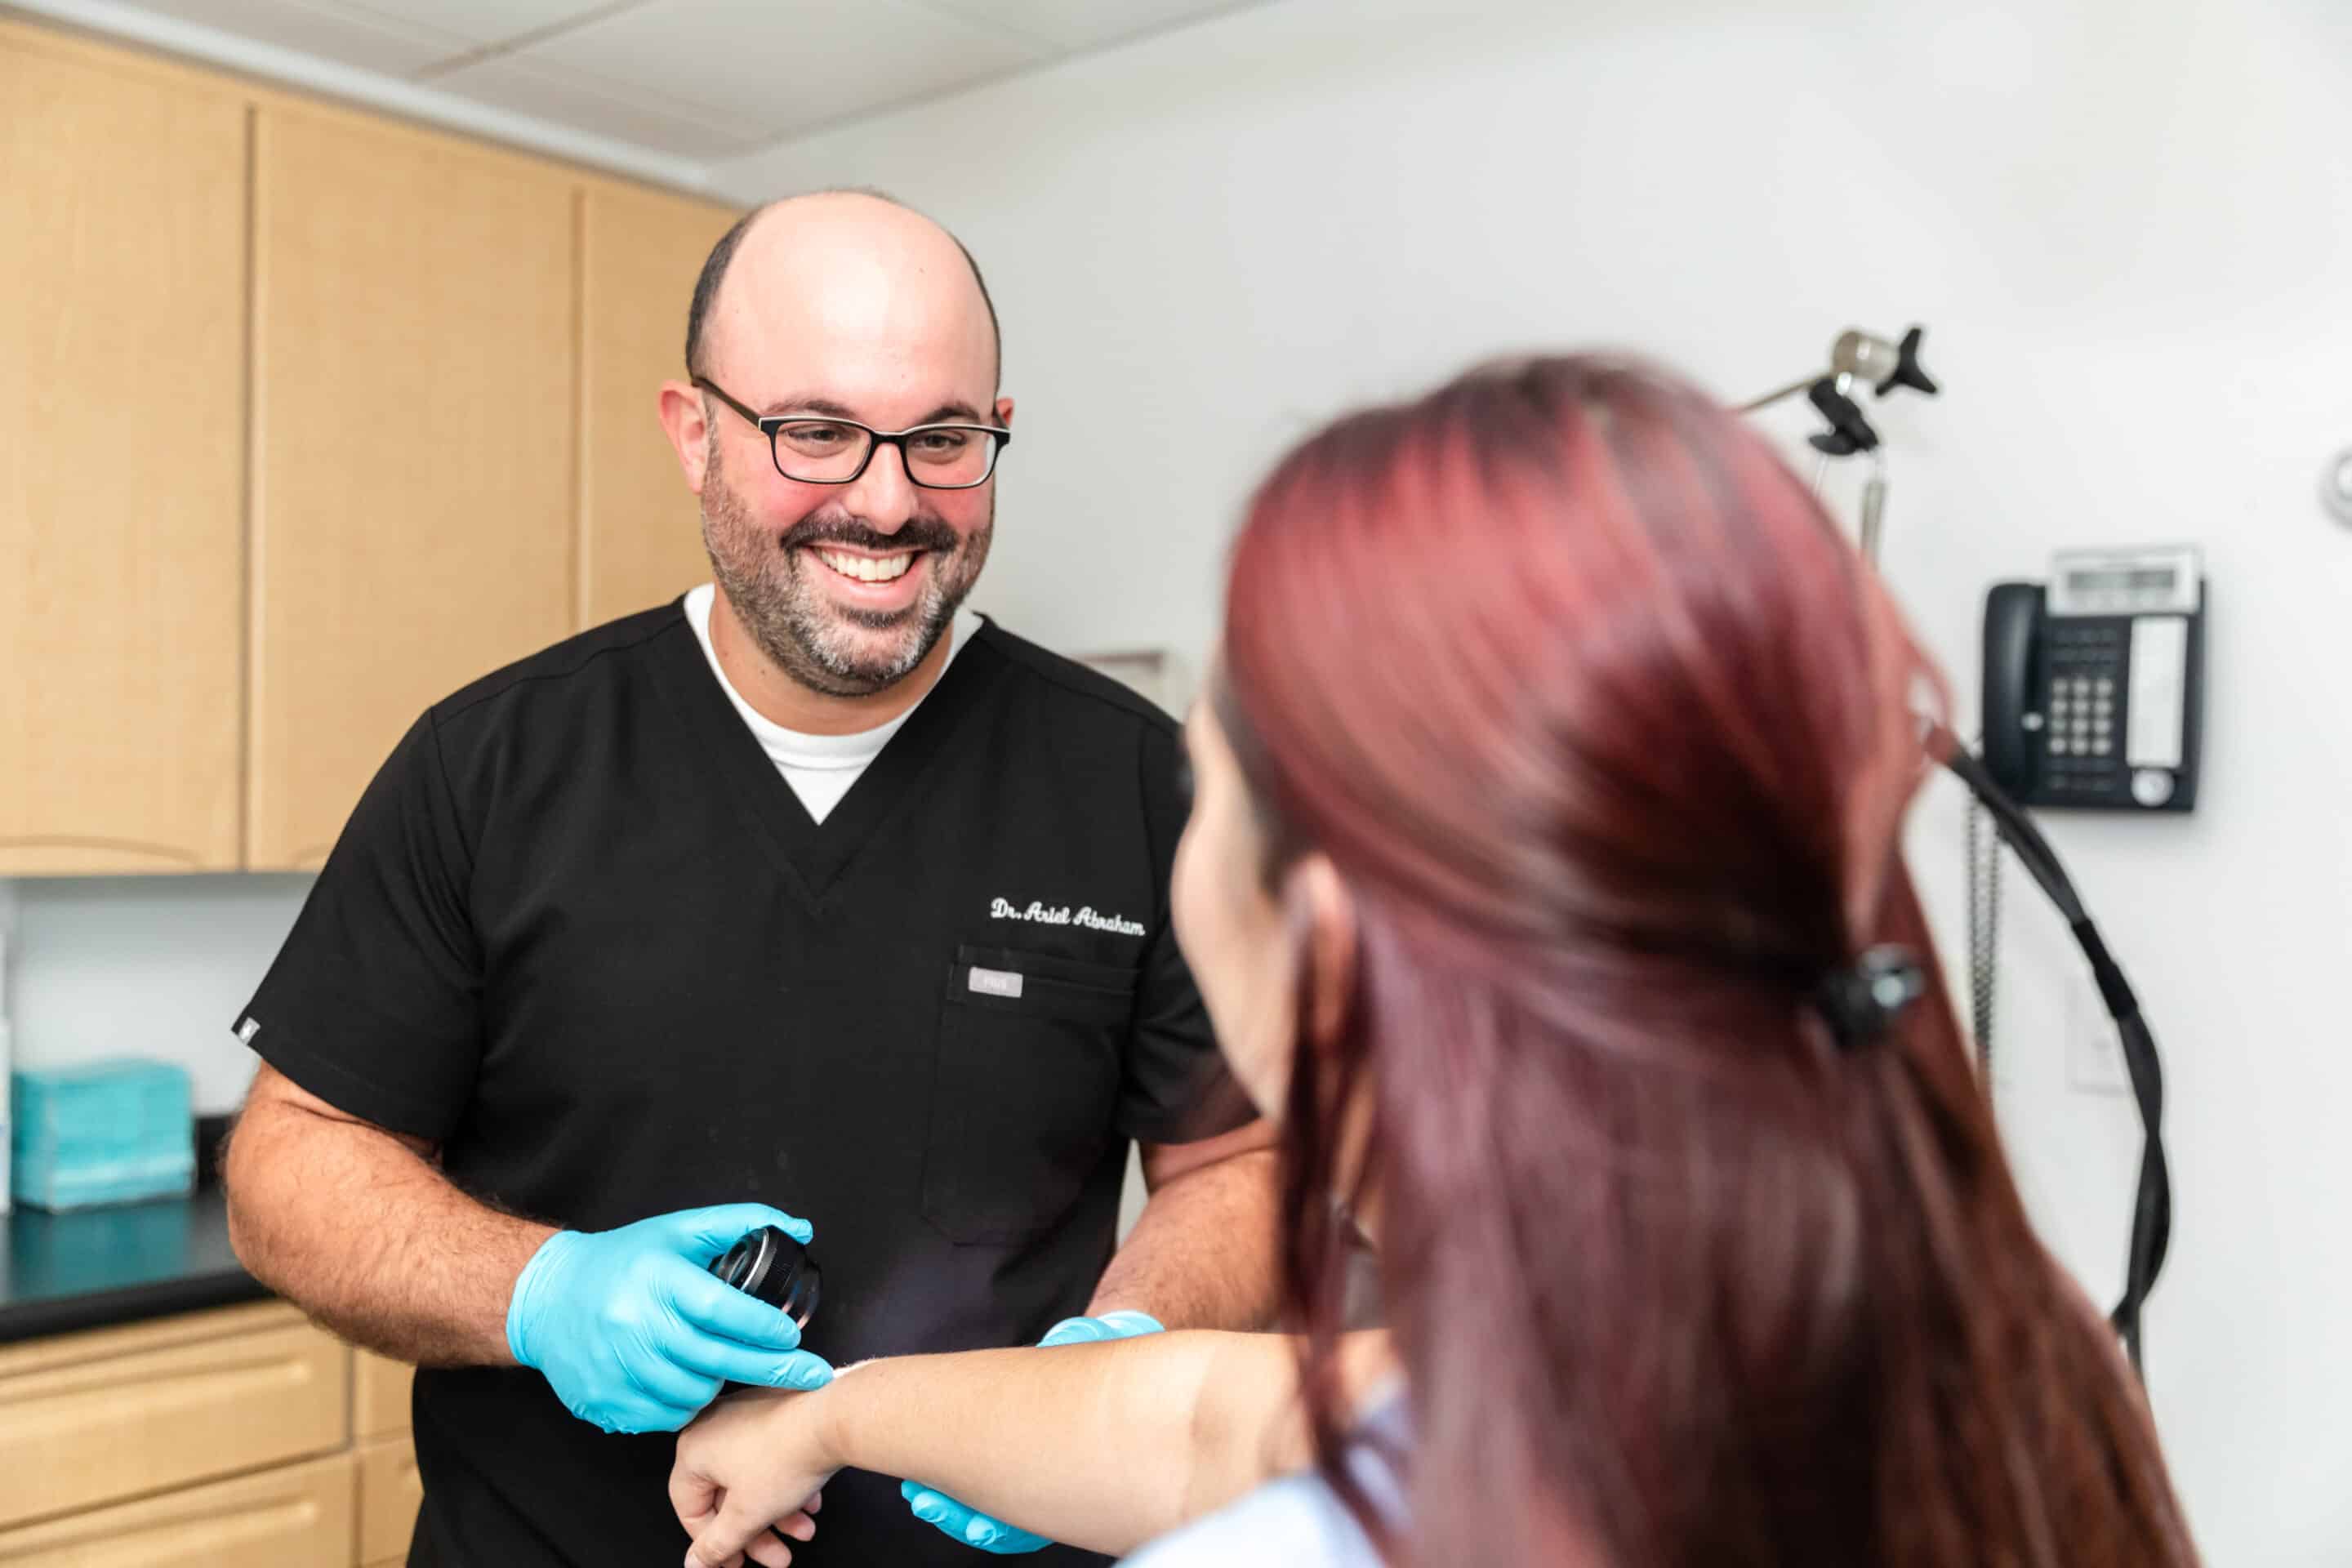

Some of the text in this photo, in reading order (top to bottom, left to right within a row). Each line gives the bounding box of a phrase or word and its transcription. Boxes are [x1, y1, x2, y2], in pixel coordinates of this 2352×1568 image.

[991, 897, 1146, 937] Dr. Ariel Abraham
